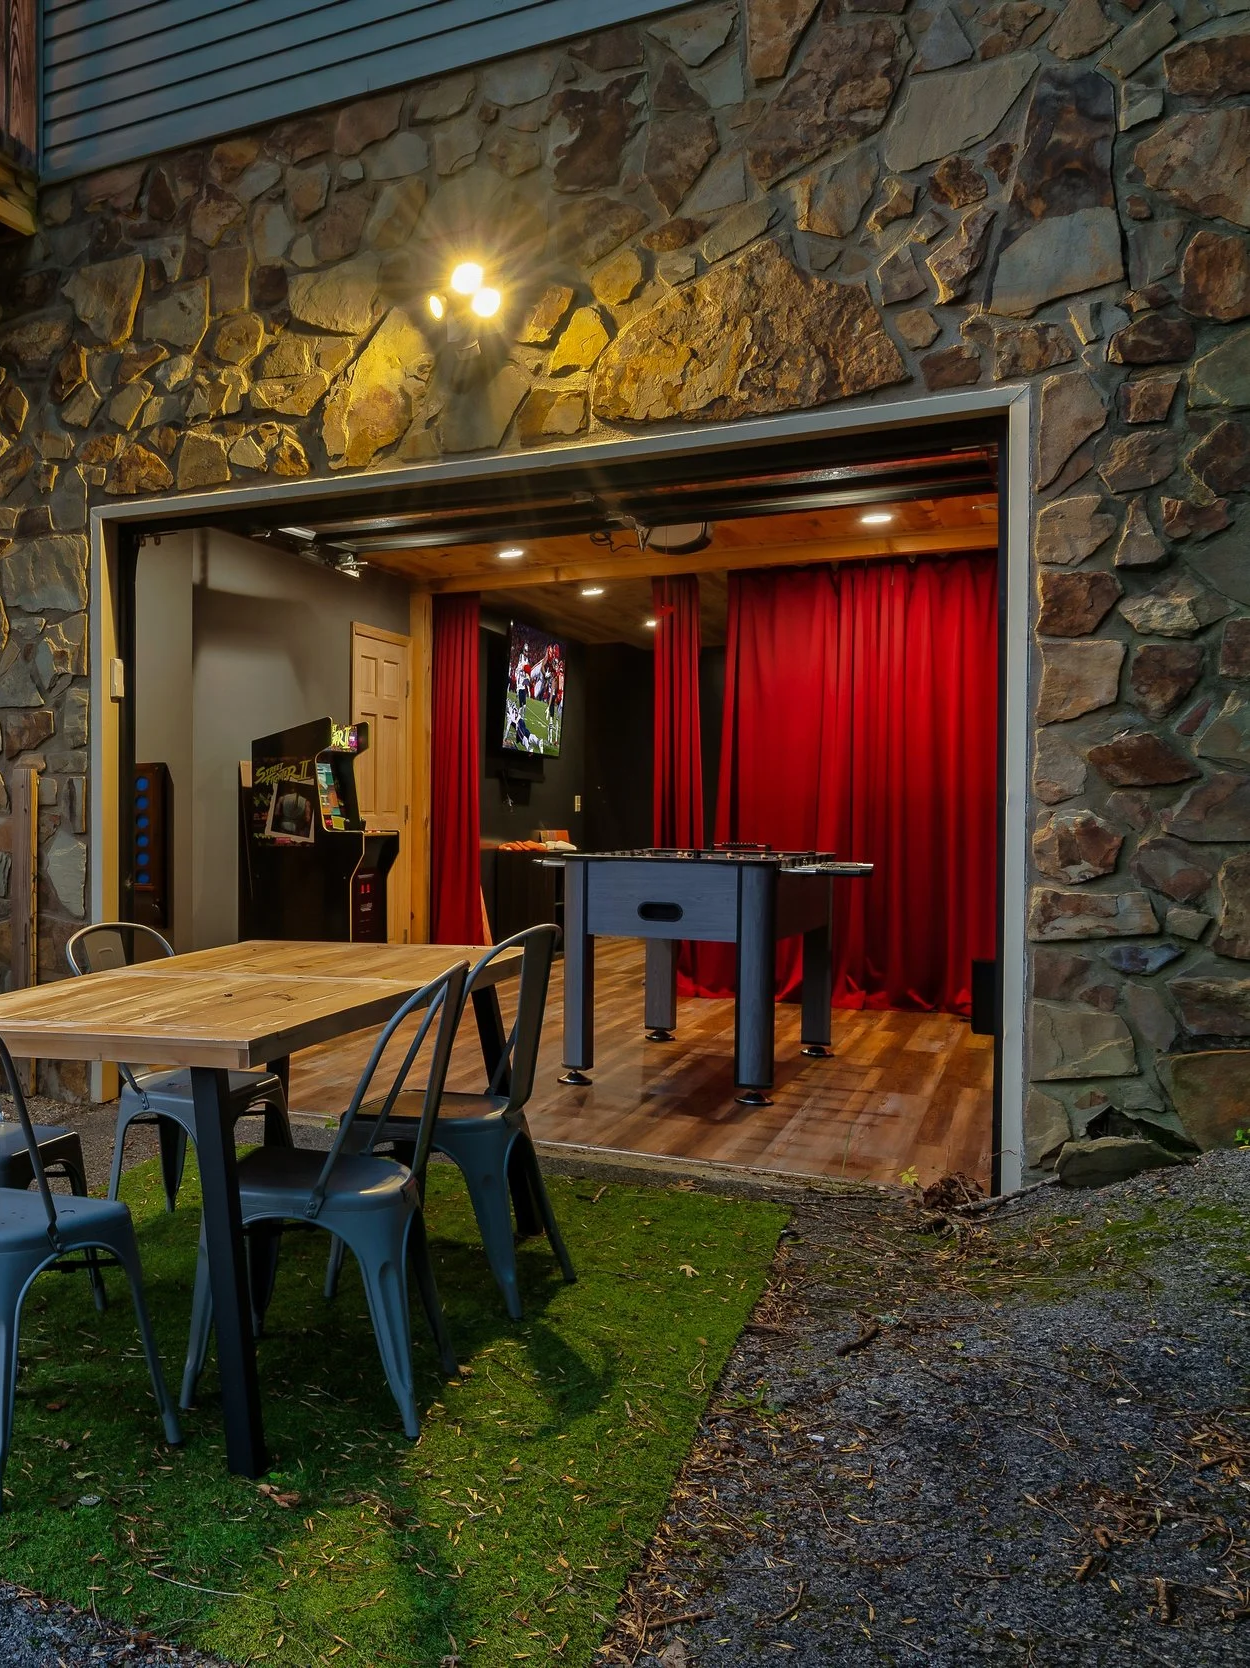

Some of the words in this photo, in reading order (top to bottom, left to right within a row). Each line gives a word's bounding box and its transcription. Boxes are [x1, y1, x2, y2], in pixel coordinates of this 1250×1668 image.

[255, 763, 284, 784] STREET
[261, 766, 300, 785] FIGHTER
[298, 759, 312, 780] II
